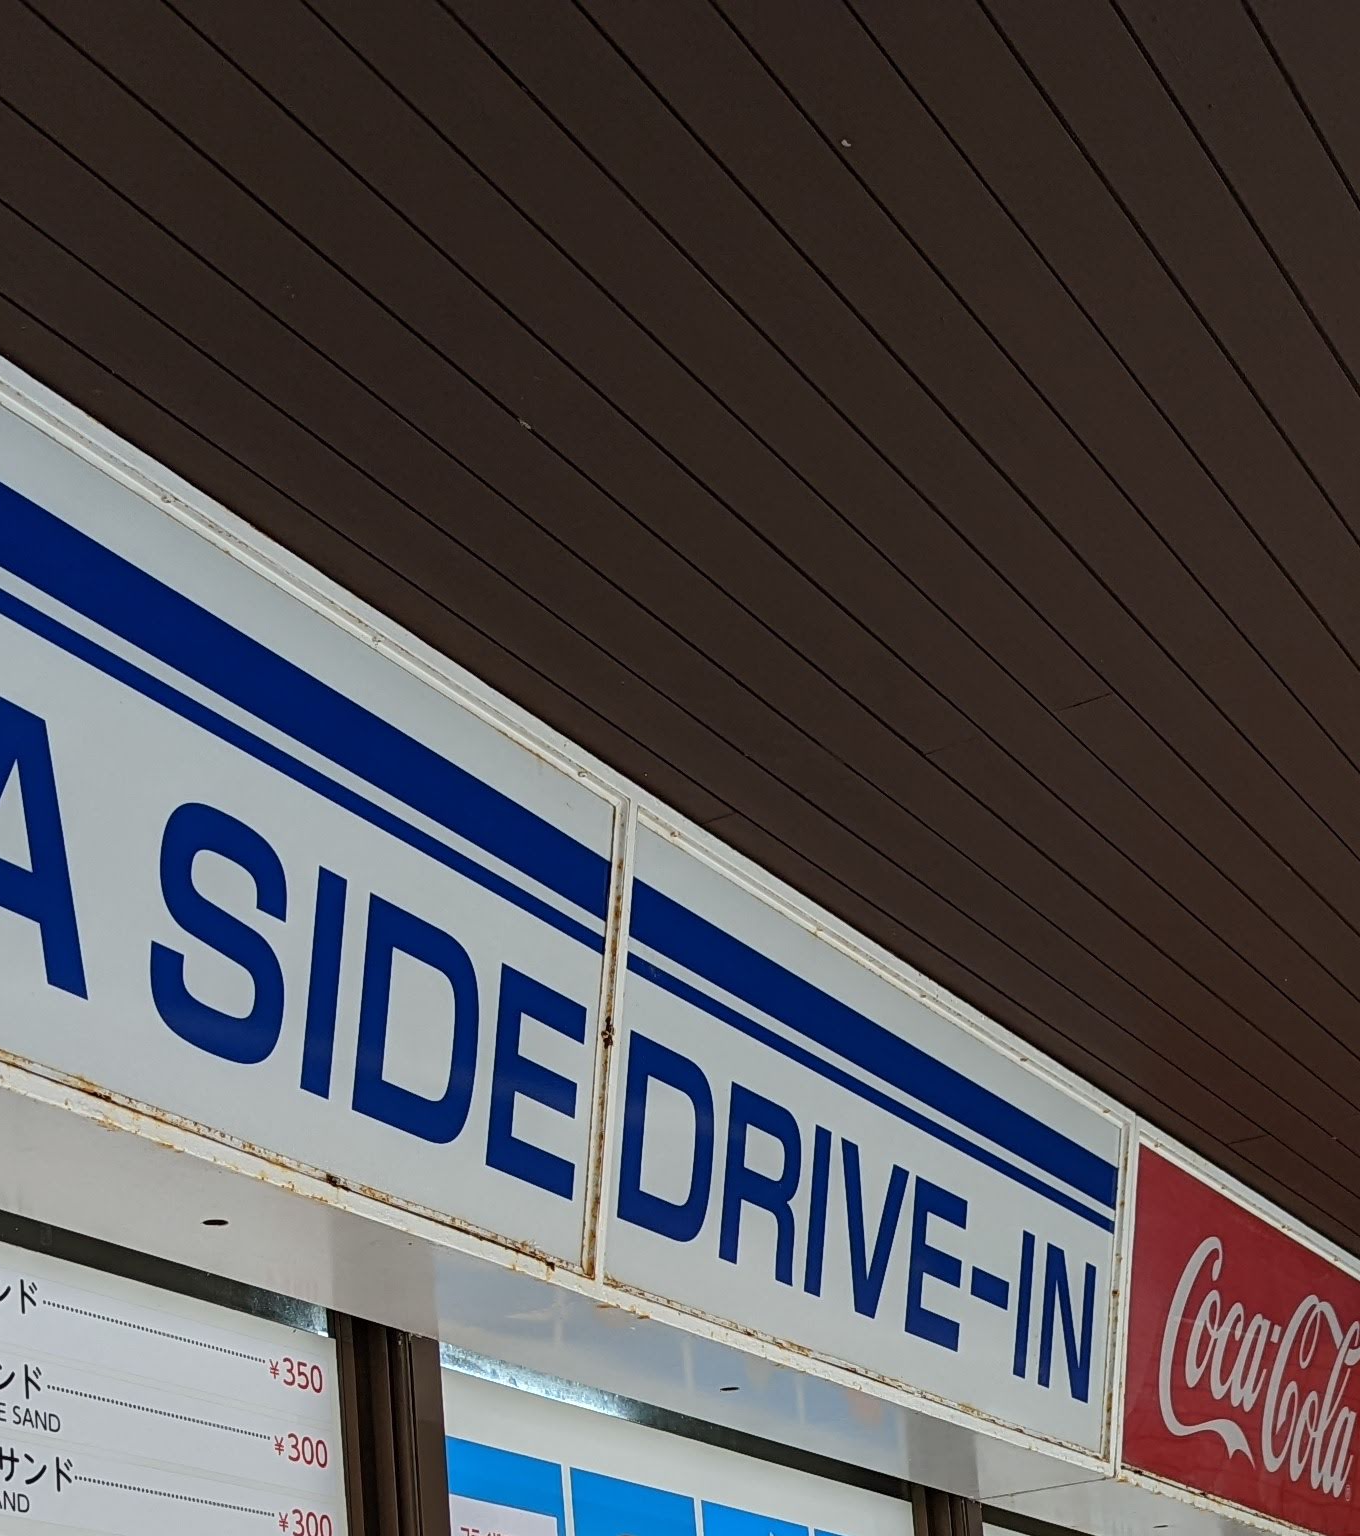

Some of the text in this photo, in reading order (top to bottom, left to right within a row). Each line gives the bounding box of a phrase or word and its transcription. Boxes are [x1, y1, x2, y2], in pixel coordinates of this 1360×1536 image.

[148, 801, 588, 1201] SIDE
[616, 1028, 1098, 1405] DRIVE-IN
[268, 1355, 325, 1396] ¥350
[9, 1401, 62, 1434] SAND
[273, 1432, 329, 1470] ¥300
